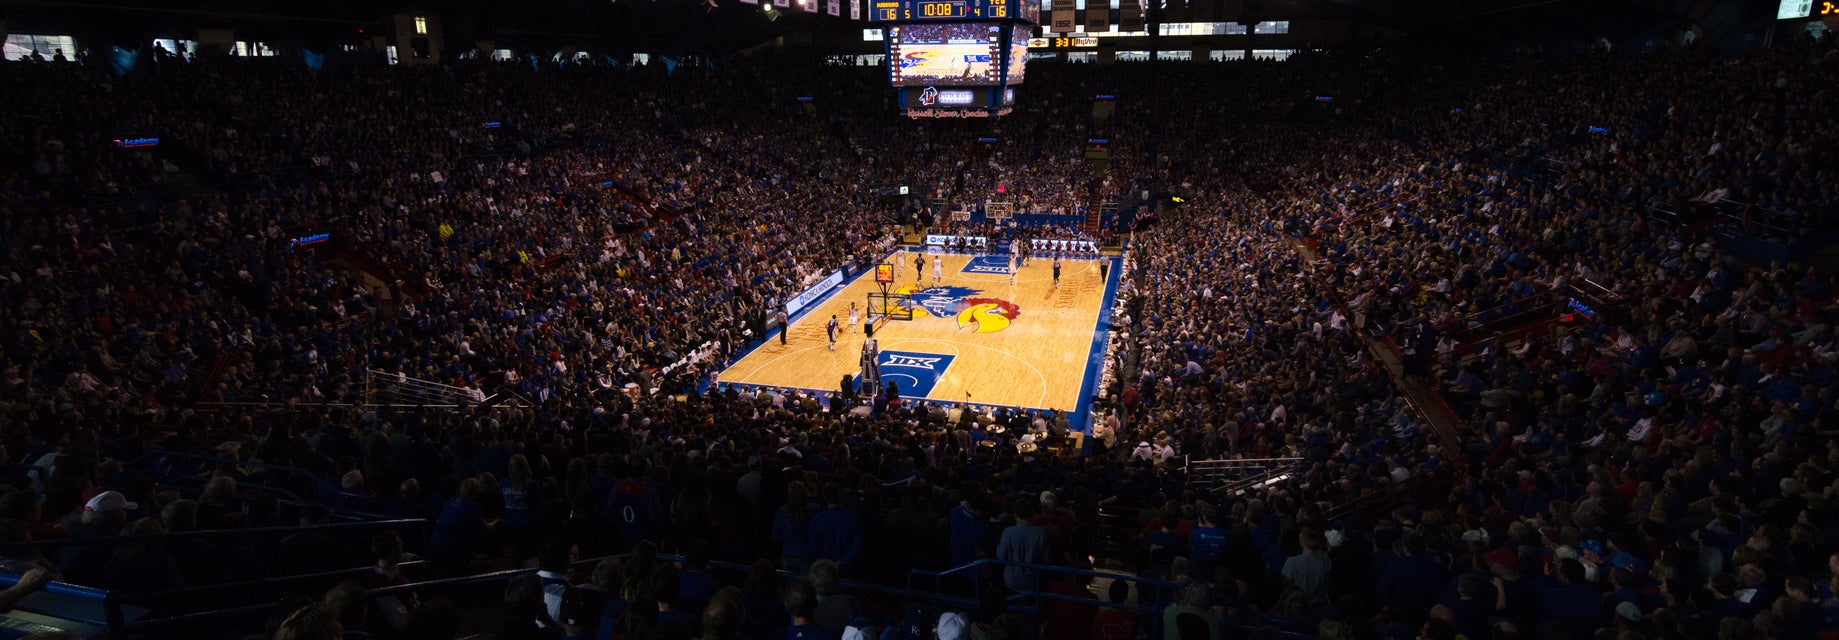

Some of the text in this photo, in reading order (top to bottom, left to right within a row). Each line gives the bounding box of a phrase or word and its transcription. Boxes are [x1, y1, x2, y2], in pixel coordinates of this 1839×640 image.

[887, 9, 897, 20] 16
[904, 9, 911, 19] 5
[924, 3, 952, 16] 10:08
[974, 8, 980, 17] 4
[996, 6, 1006, 17] 16
